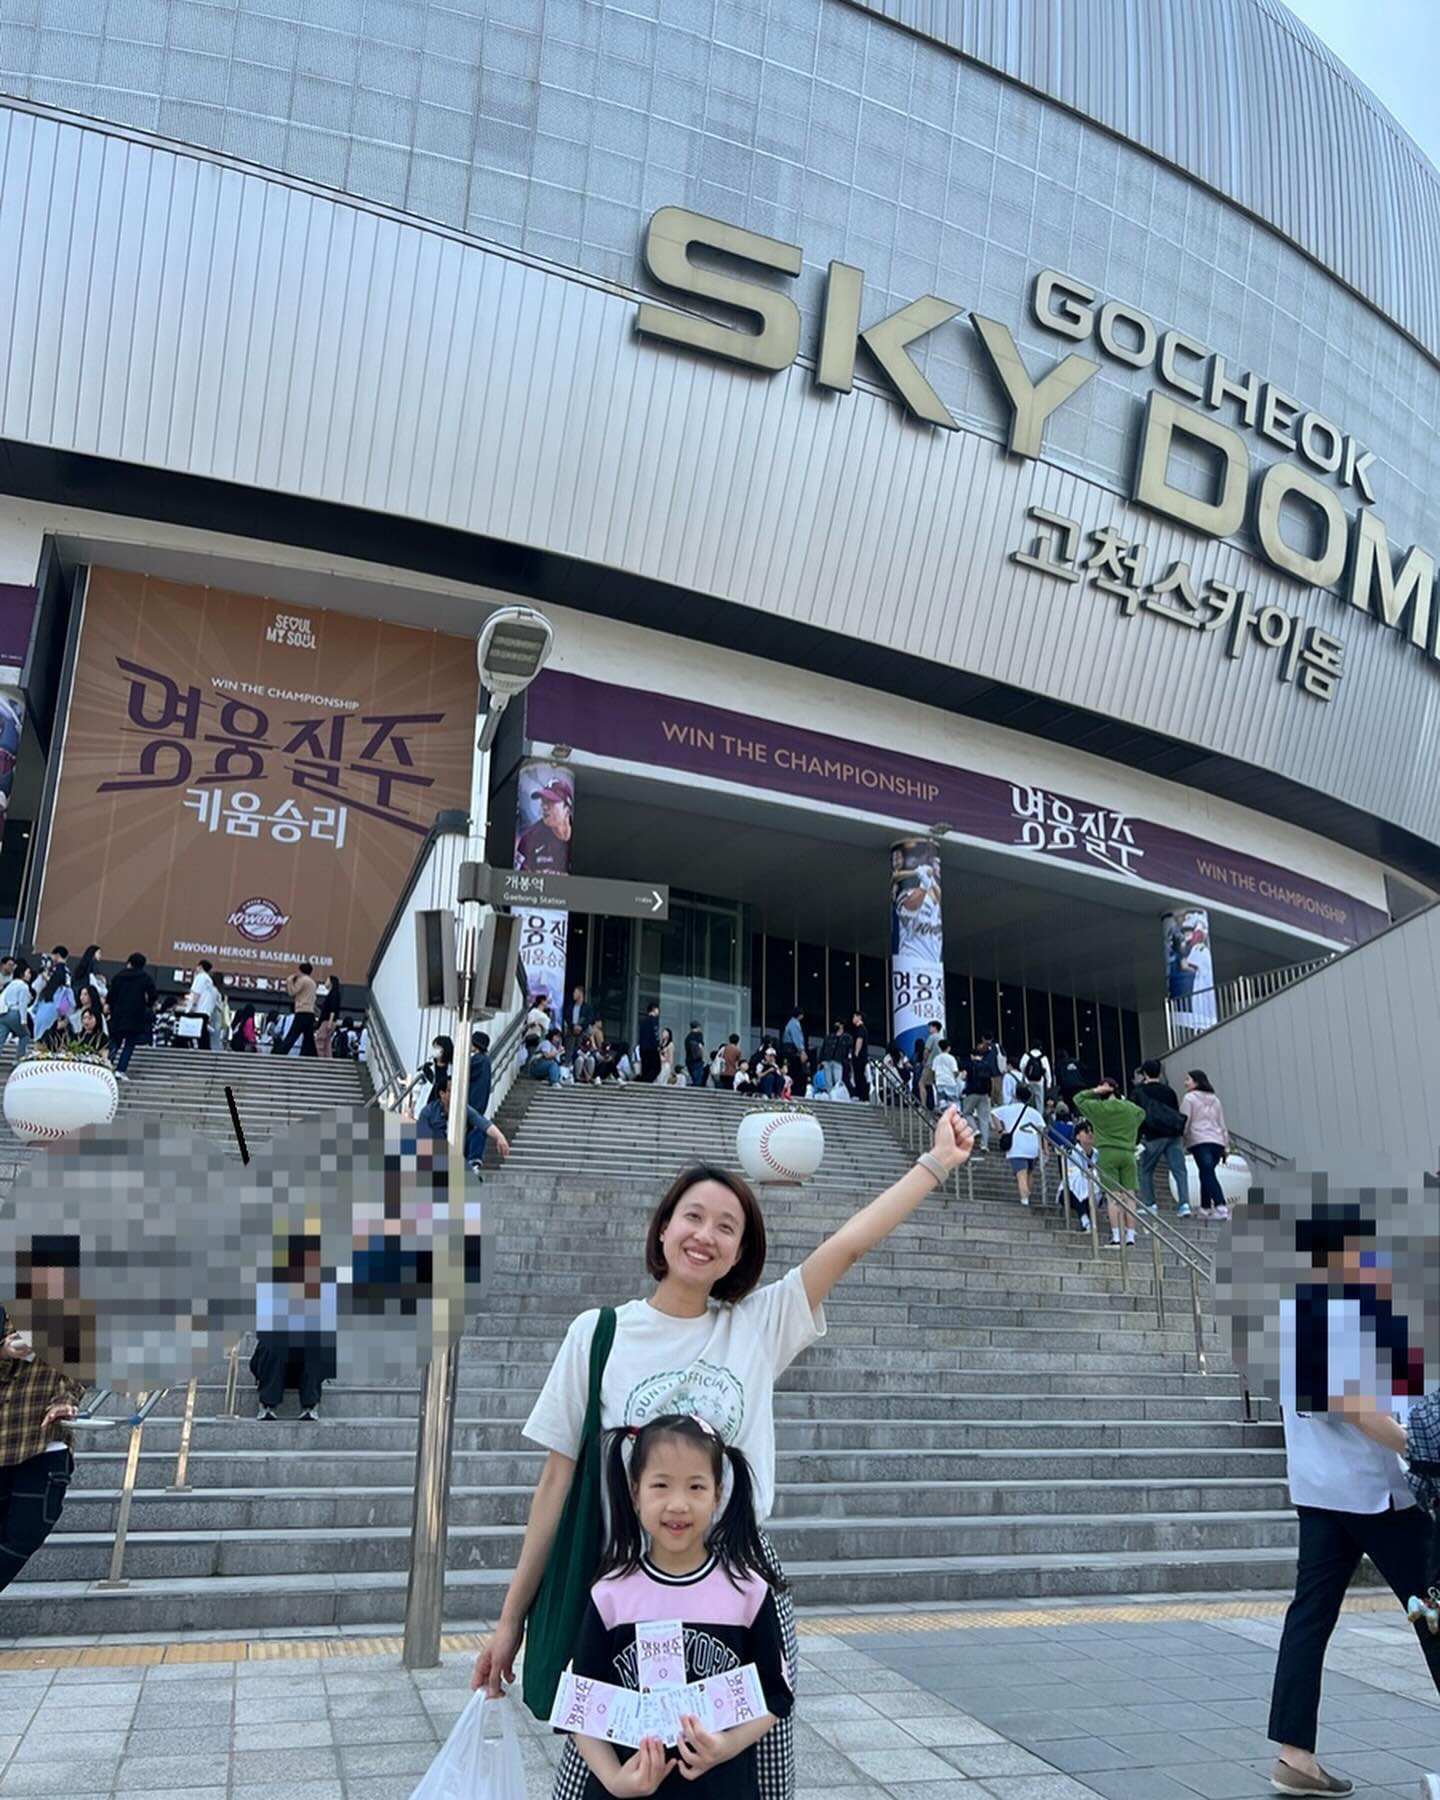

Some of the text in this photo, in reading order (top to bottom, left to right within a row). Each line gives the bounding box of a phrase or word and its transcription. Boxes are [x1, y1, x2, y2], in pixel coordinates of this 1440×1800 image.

[1031, 268, 1377, 505] GOCHEOK
[634, 205, 1440, 662] SKY DOM
[1010, 506, 1346, 702] 고척스카이돔
[266, 626, 317, 649] MY SOUL
[211, 677, 360, 710] WIN THE CHAMPIONSHIP
[662, 720, 940, 801] WIN THE CHAMPIONSHIP
[182, 788, 348, 849] 키움승리
[505, 874, 545, 893] 개봉역
[1196, 858, 1348, 926] WIN THE CHAMPIONSHIP
[173, 941, 218, 954] KIWOOM
[219, 946, 258, 958] HEROES
[259, 950, 307, 964] BASEBALL
[308, 955, 334, 966] CLUB
[518, 914, 568, 955] 웅질
